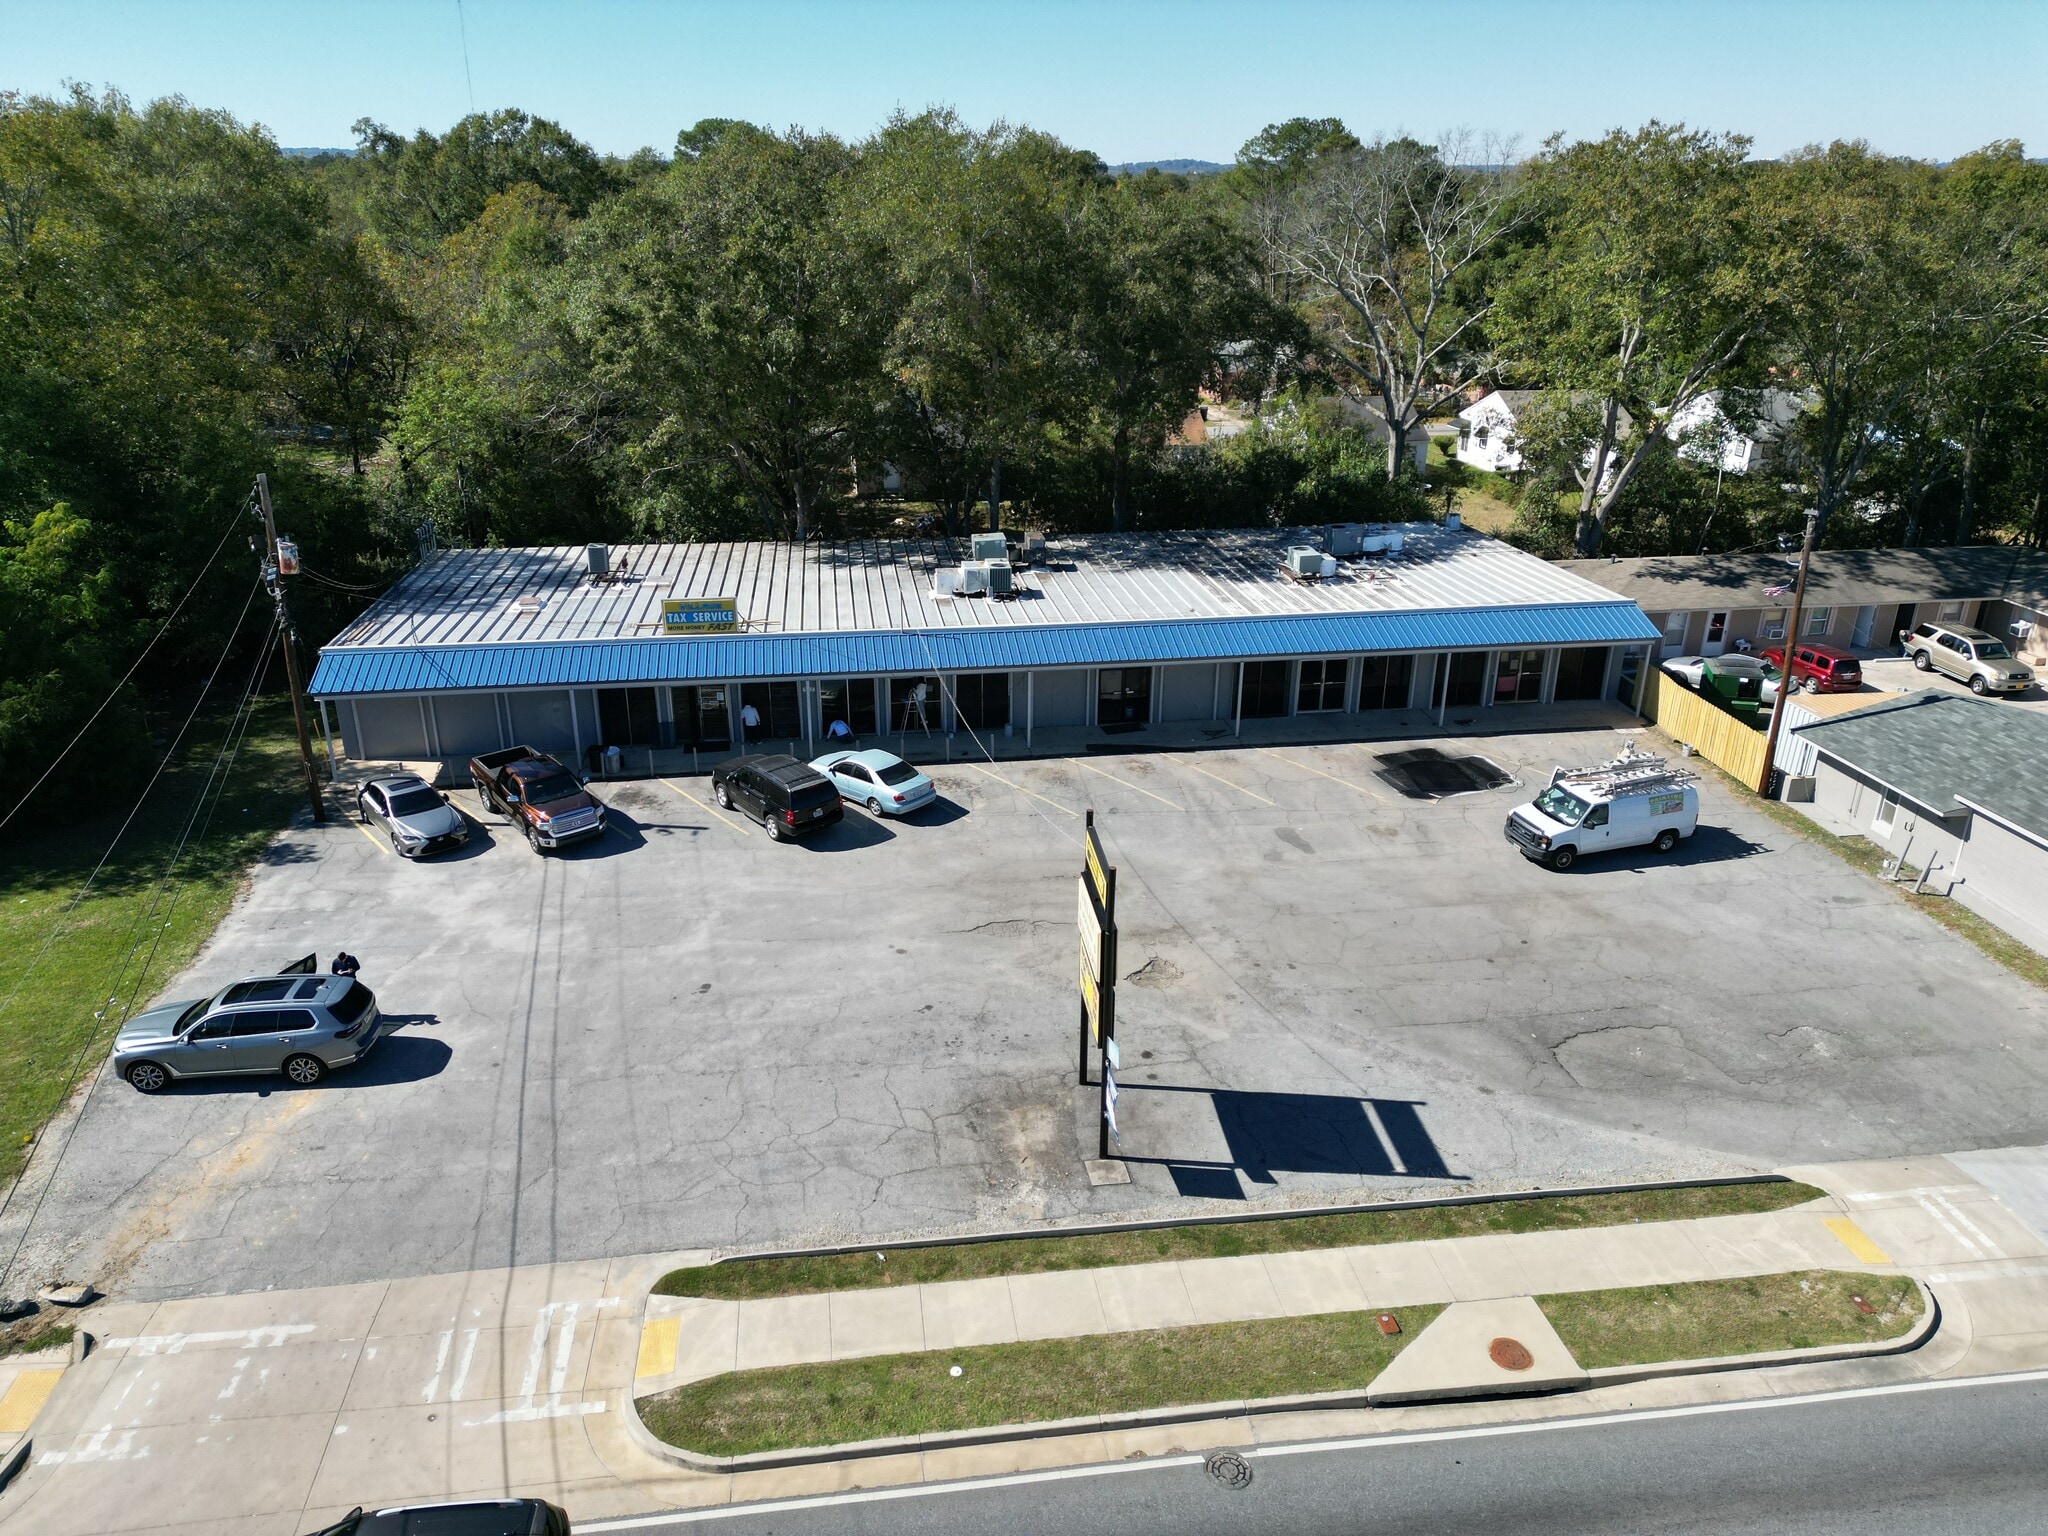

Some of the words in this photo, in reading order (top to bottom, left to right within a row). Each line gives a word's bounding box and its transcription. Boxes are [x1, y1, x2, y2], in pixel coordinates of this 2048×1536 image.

[667, 613, 687, 623] TAX
[693, 611, 733, 622] SERVICE
[707, 623, 734, 631] FAST
